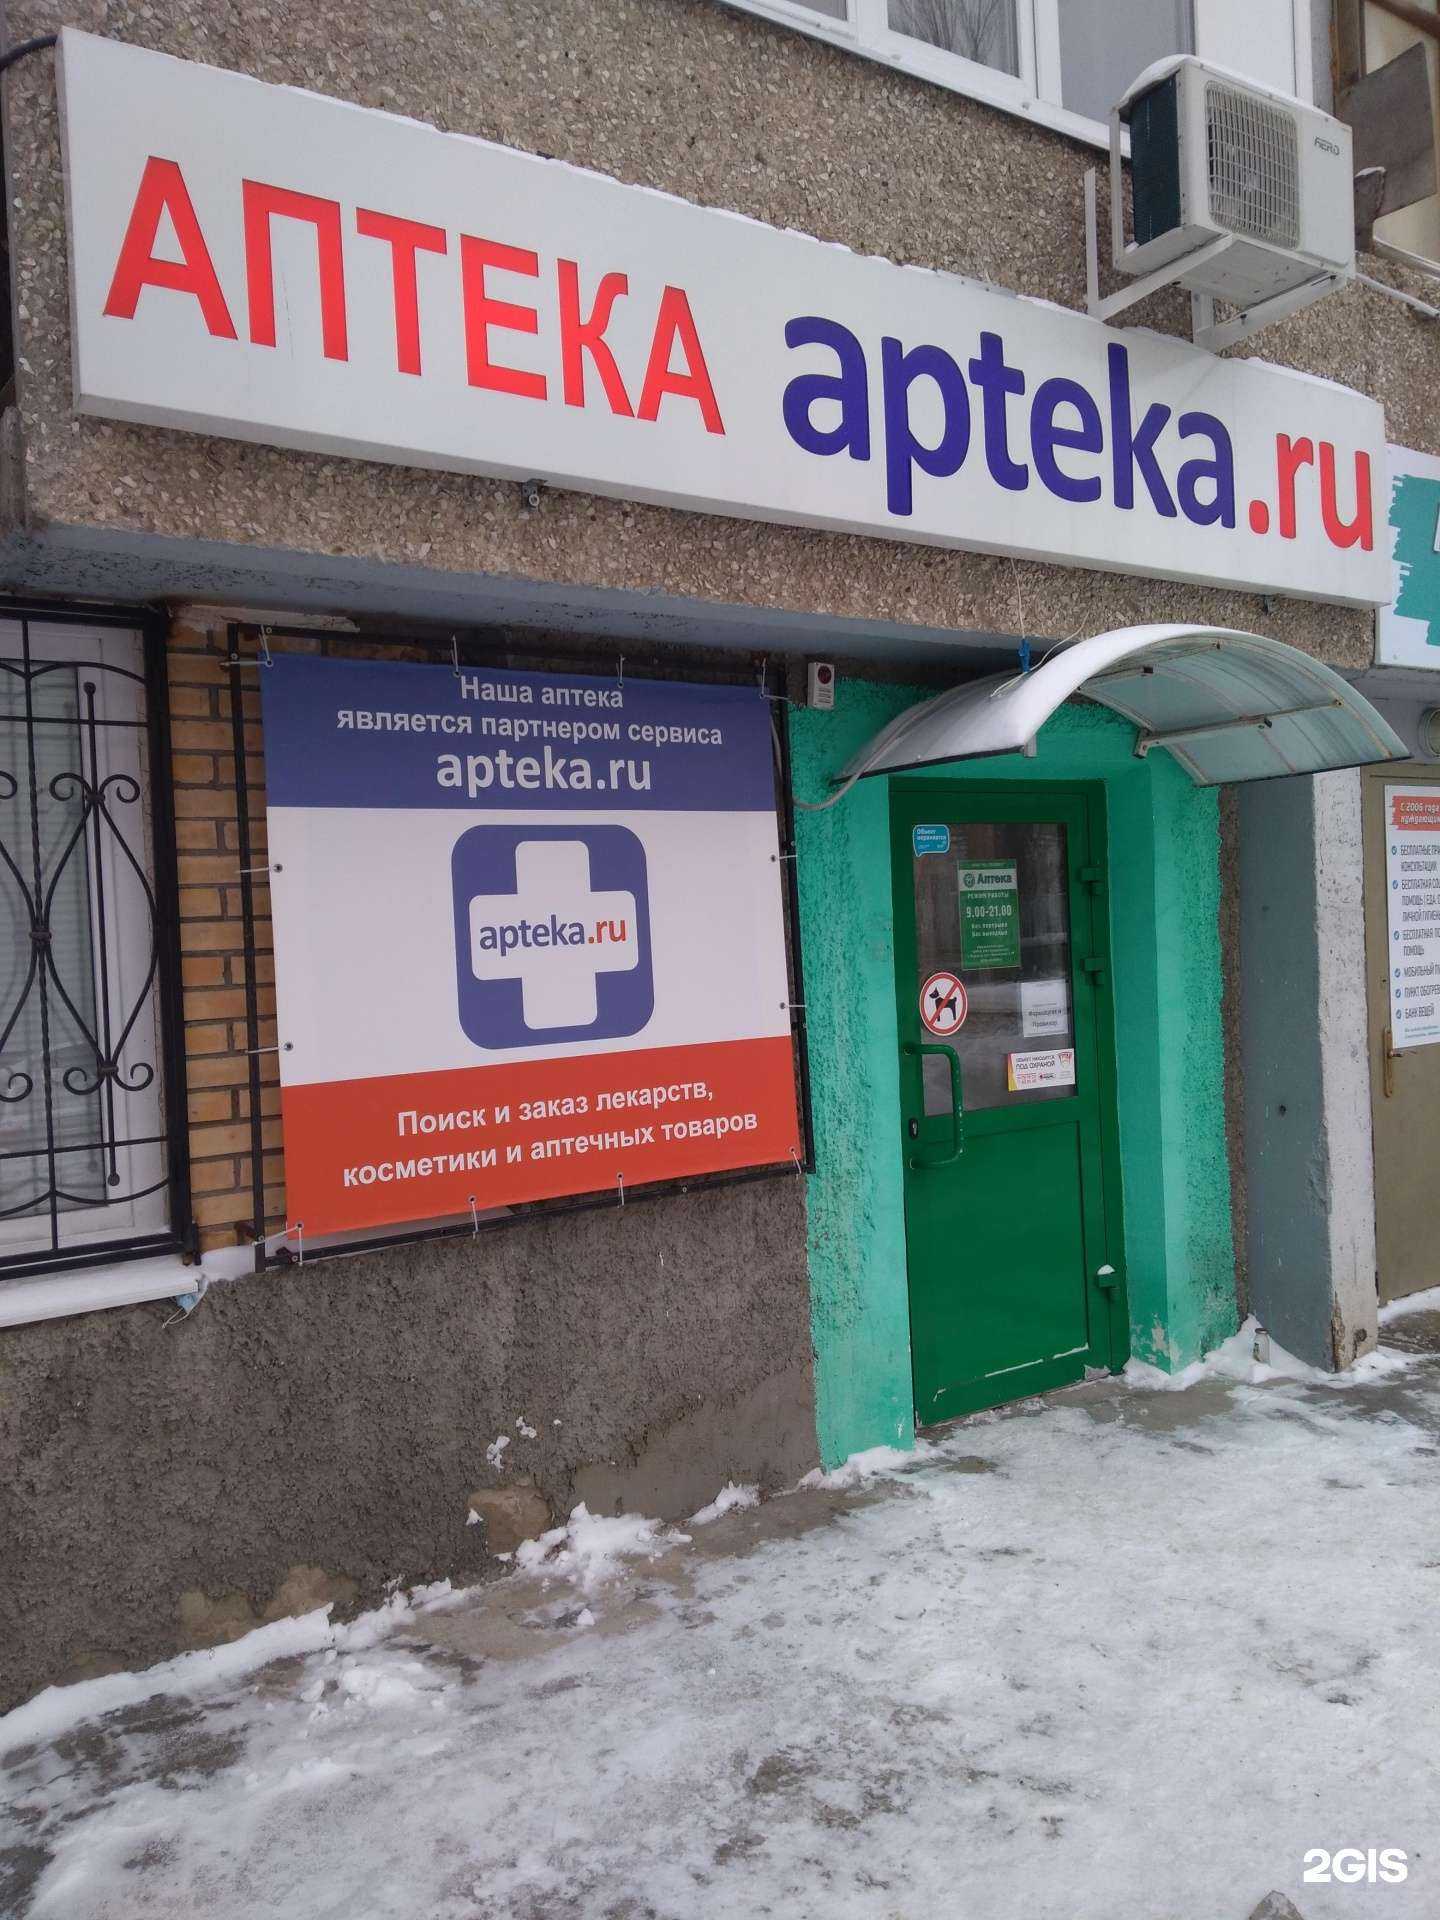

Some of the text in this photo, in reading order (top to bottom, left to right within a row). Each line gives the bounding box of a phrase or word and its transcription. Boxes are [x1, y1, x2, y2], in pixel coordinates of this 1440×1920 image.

[1314, 136, 1341, 156] AERO
[102, 155, 1374, 551] АПТЕКА apteka.ru
[461, 675, 624, 710] Наша аптека
[337, 708, 723, 747] является партнером сервиса
[437, 744, 652, 799] apteka.ru
[977, 873, 1013, 884] Аптека
[480, 914, 627, 957] apteka.ru
[398, 1080, 714, 1137] Поиск и заказ лекарств,
[343, 1112, 758, 1188] косметики и аптечных товаров
